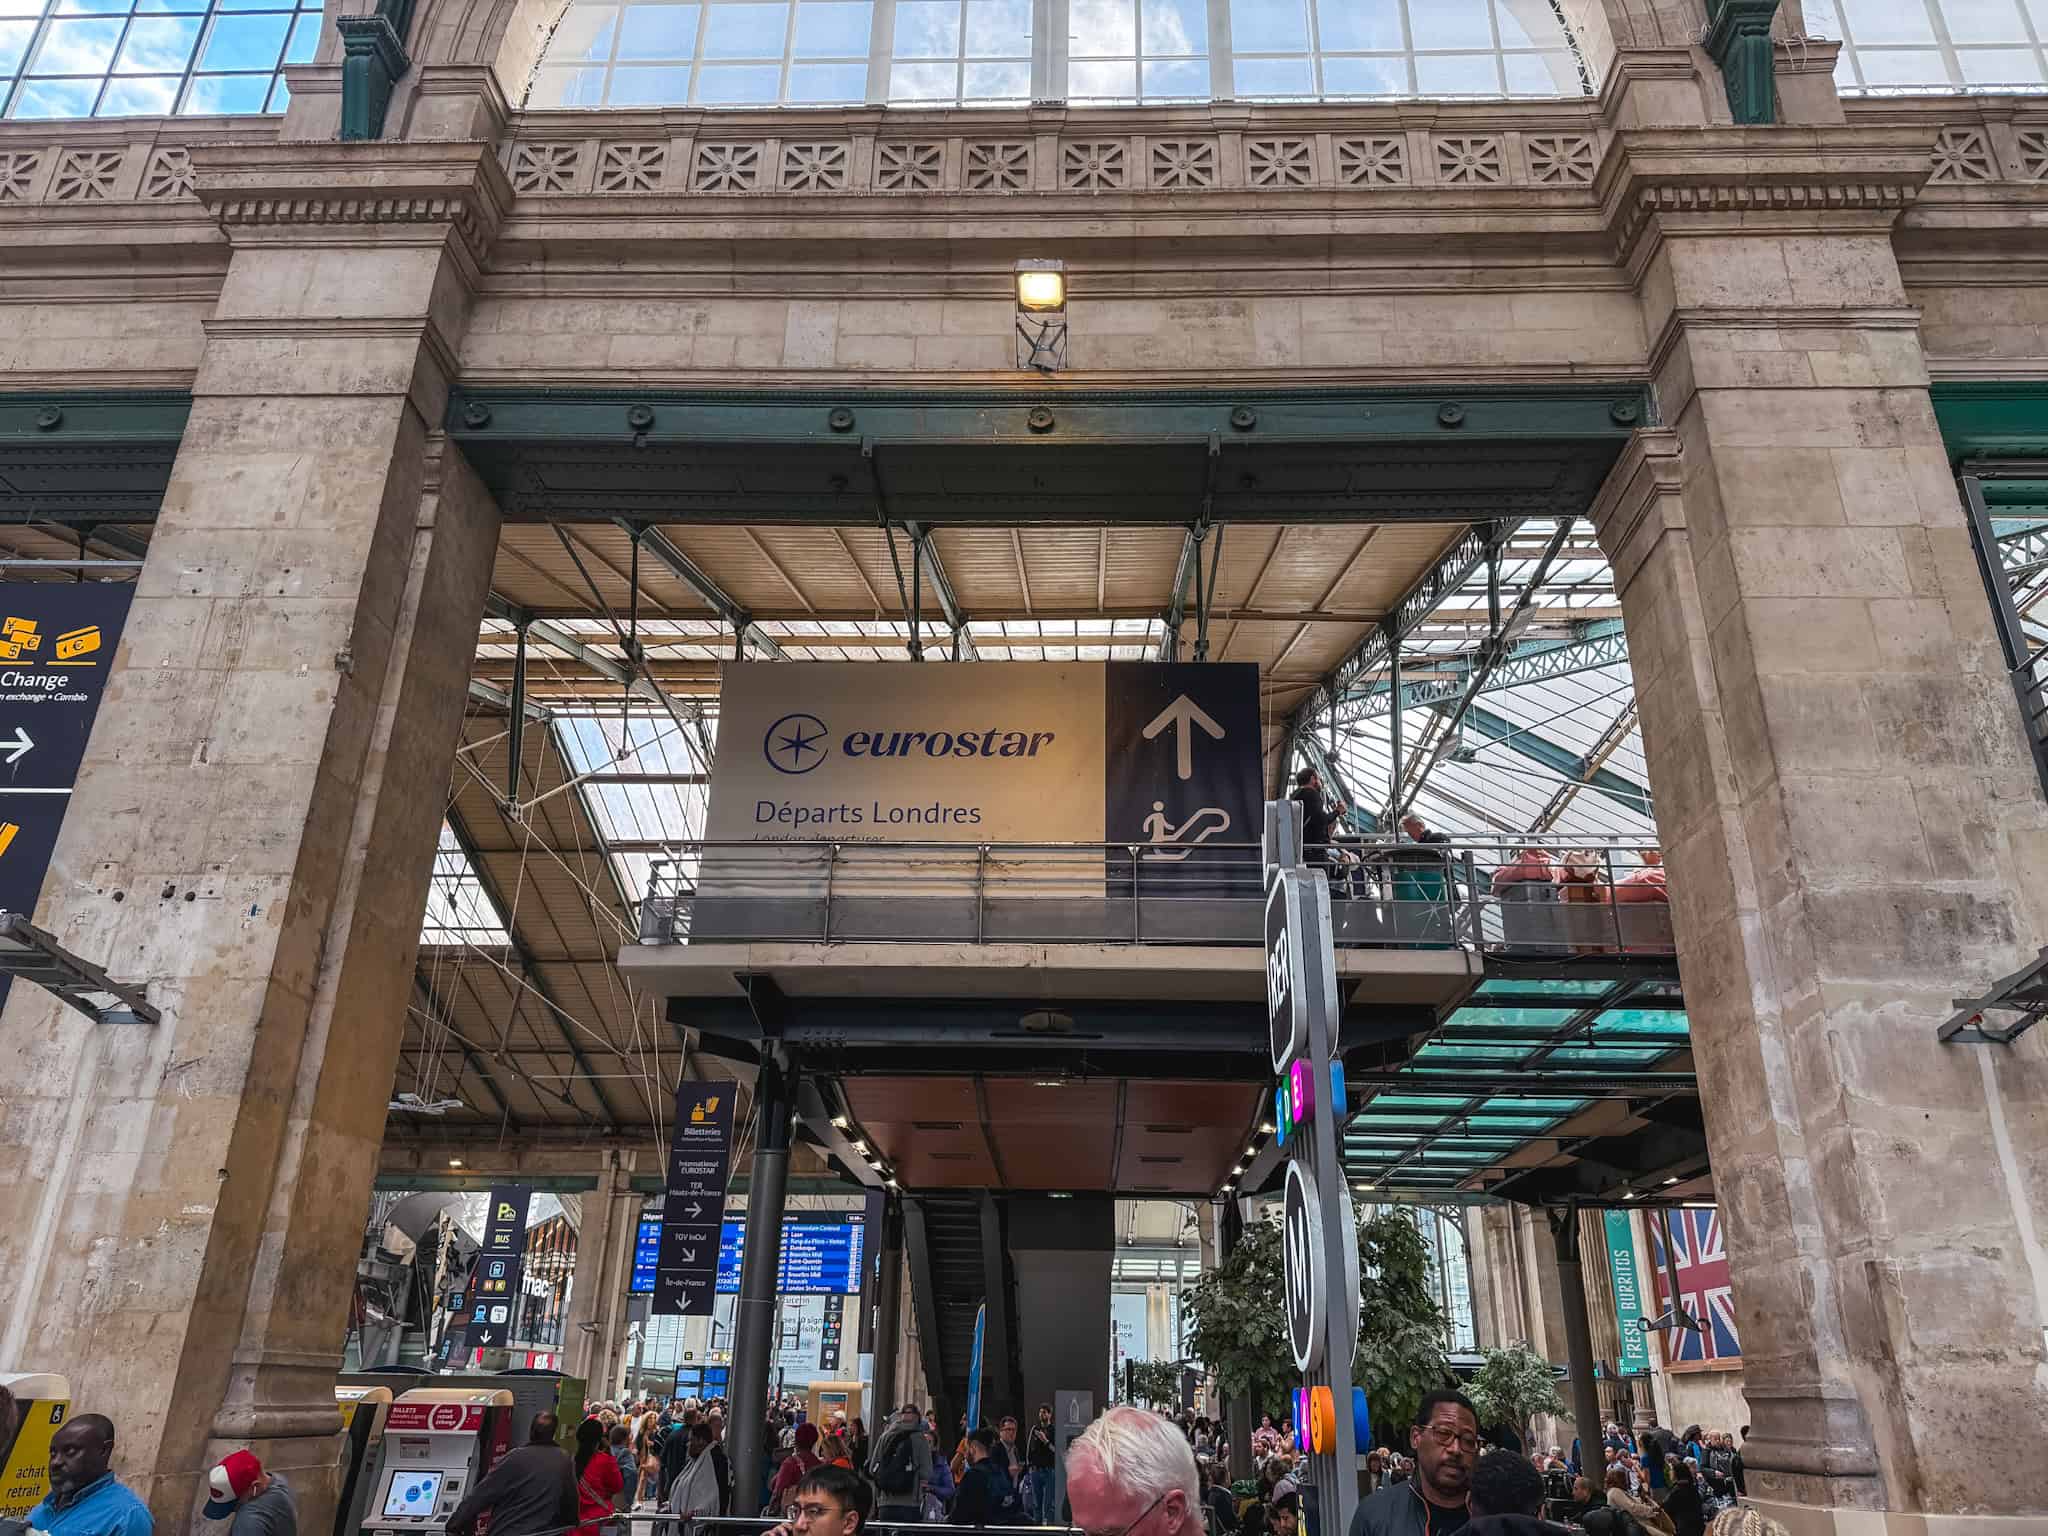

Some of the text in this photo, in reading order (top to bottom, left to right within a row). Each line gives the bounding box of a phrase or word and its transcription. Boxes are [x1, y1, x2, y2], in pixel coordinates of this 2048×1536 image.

[0, 671, 69, 691] Change
[842, 727, 1056, 758] eurostar
[755, 801, 982, 828] Départs Londres
[1269, 927, 1290, 1019] RER
[1293, 1073, 1301, 1110] E
[495, 1234, 511, 1244] BUS
[1288, 1206, 1308, 1321] M
[521, 1269, 549, 1298] fnac
[1613, 1249, 1637, 1312] BURRITOS
[1623, 1319, 1644, 1359] FRESH
[15, 1464, 46, 1479] achat
[6, 1484, 41, 1498] retrait
